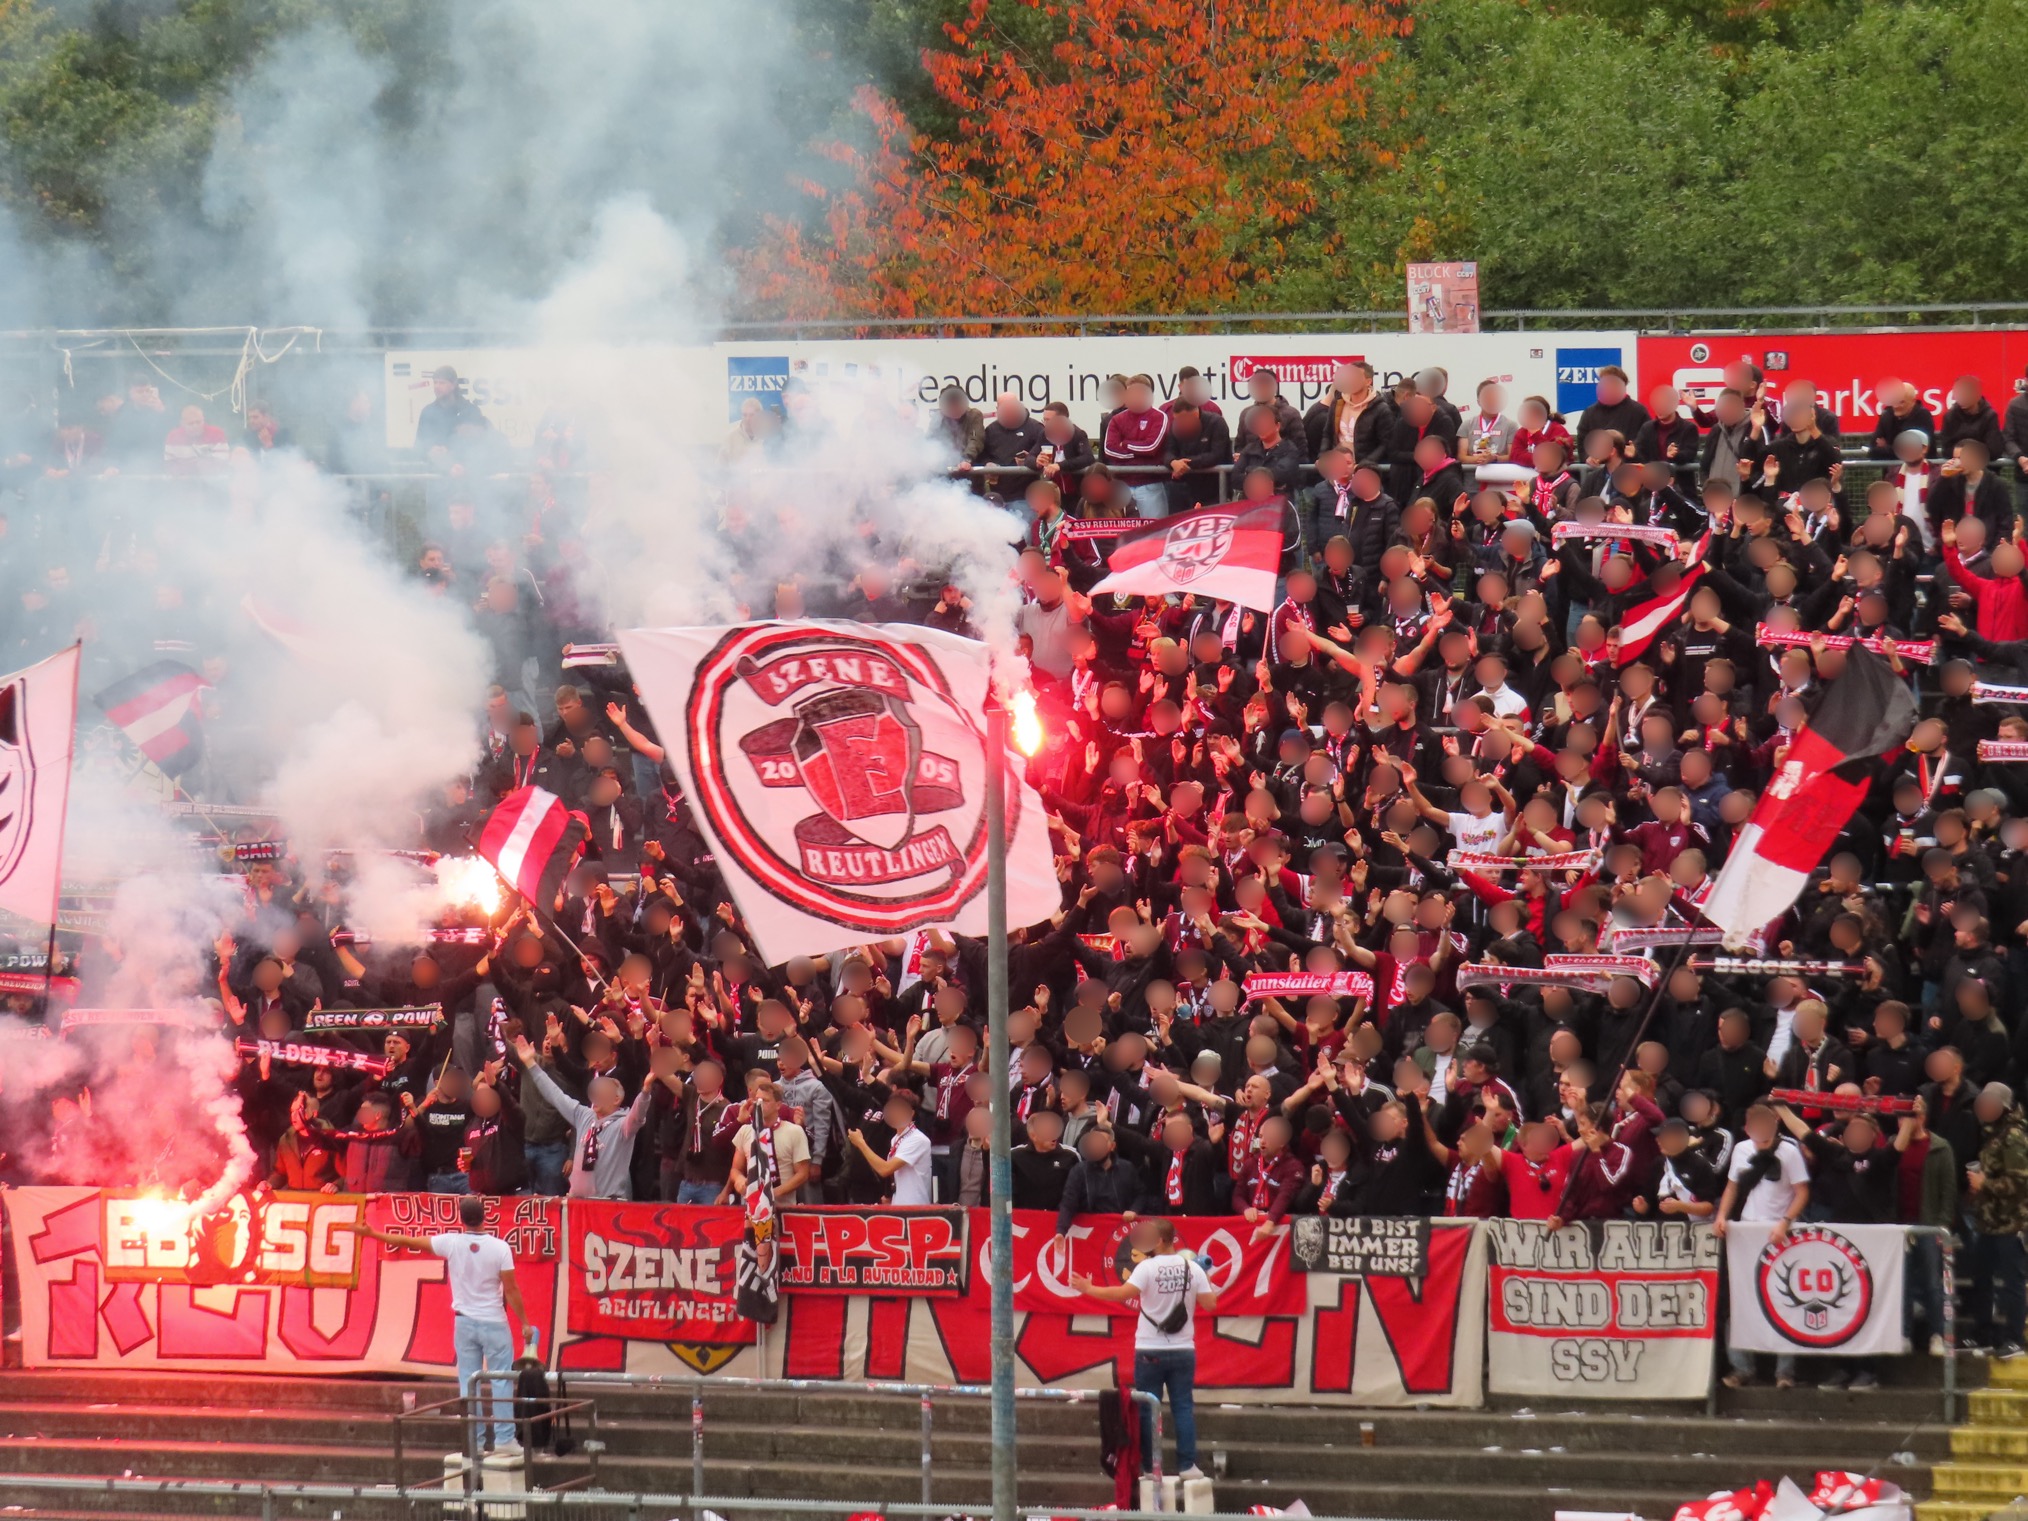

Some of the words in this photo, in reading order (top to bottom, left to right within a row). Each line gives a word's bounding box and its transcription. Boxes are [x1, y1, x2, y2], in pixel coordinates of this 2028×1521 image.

[1408, 266, 1451, 279] BLOCK
[730, 375, 788, 392] ZEISS
[1074, 521, 1092, 530] SSV
[1093, 519, 1142, 529] REUTLINGEN
[767, 657, 896, 695] SZENE
[760, 761, 796, 780] 20
[919, 760, 954, 783] 05
[806, 831, 949, 879] REUTLINGEN
[7, 955, 69, 968] POWR
[1714, 957, 1800, 975] BLOCK
[258, 1040, 330, 1066] BLOCK
[391, 1195, 501, 1225] ONOE
[513, 1197, 552, 1225] AI
[262, 1202, 358, 1274] SG
[1328, 1217, 1356, 1237] DU
[1369, 1218, 1419, 1238] BIST
[781, 1213, 953, 1271] TPSP
[1328, 1237, 1420, 1259] IMMER
[1489, 1218, 1593, 1272] WIR
[1600, 1220, 1720, 1273] ALLE
[584, 1231, 722, 1295] SZENE
[791, 1265, 814, 1283] NO
[819, 1266, 831, 1282] A
[837, 1266, 857, 1281] LA
[862, 1267, 944, 1286] AUTORIDAD
[1328, 1255, 1366, 1270] BEI
[1369, 1254, 1418, 1274] UNS!
[599, 1296, 745, 1323] REUTLINGEN
[1503, 1277, 1612, 1329] SIND
[1616, 1280, 1707, 1330] DER
[1551, 1339, 1645, 1383] SSV
